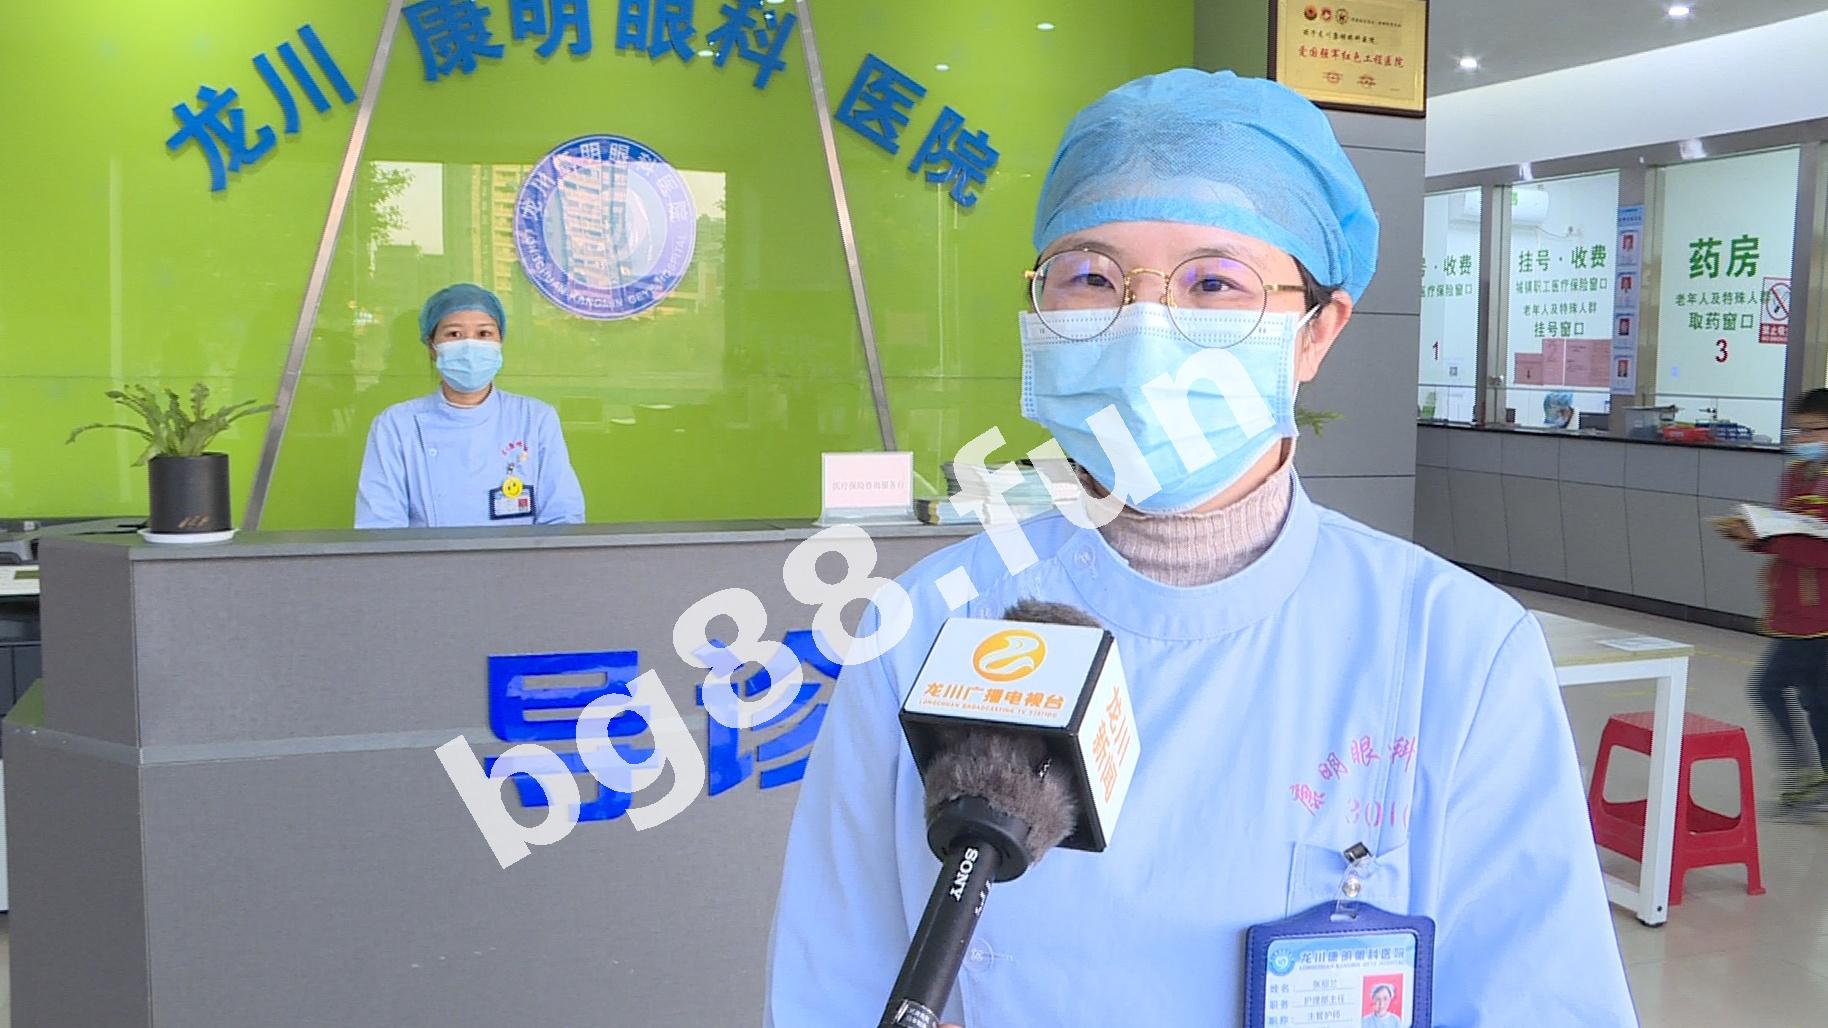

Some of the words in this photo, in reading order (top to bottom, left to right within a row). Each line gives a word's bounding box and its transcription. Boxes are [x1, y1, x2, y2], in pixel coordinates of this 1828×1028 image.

[1689, 234, 1760, 279] 药房
[1523, 301, 1598, 317] 老年人及特殊人群
[1534, 321, 1585, 338] 挂号窗口
[1688, 312, 1754, 331] 取药窗口
[1432, 340, 1439, 361] 1
[1715, 338, 1729, 363] 3
[924, 681, 1065, 711] 龙川广播电视台
[949, 847, 979, 902] SONY
